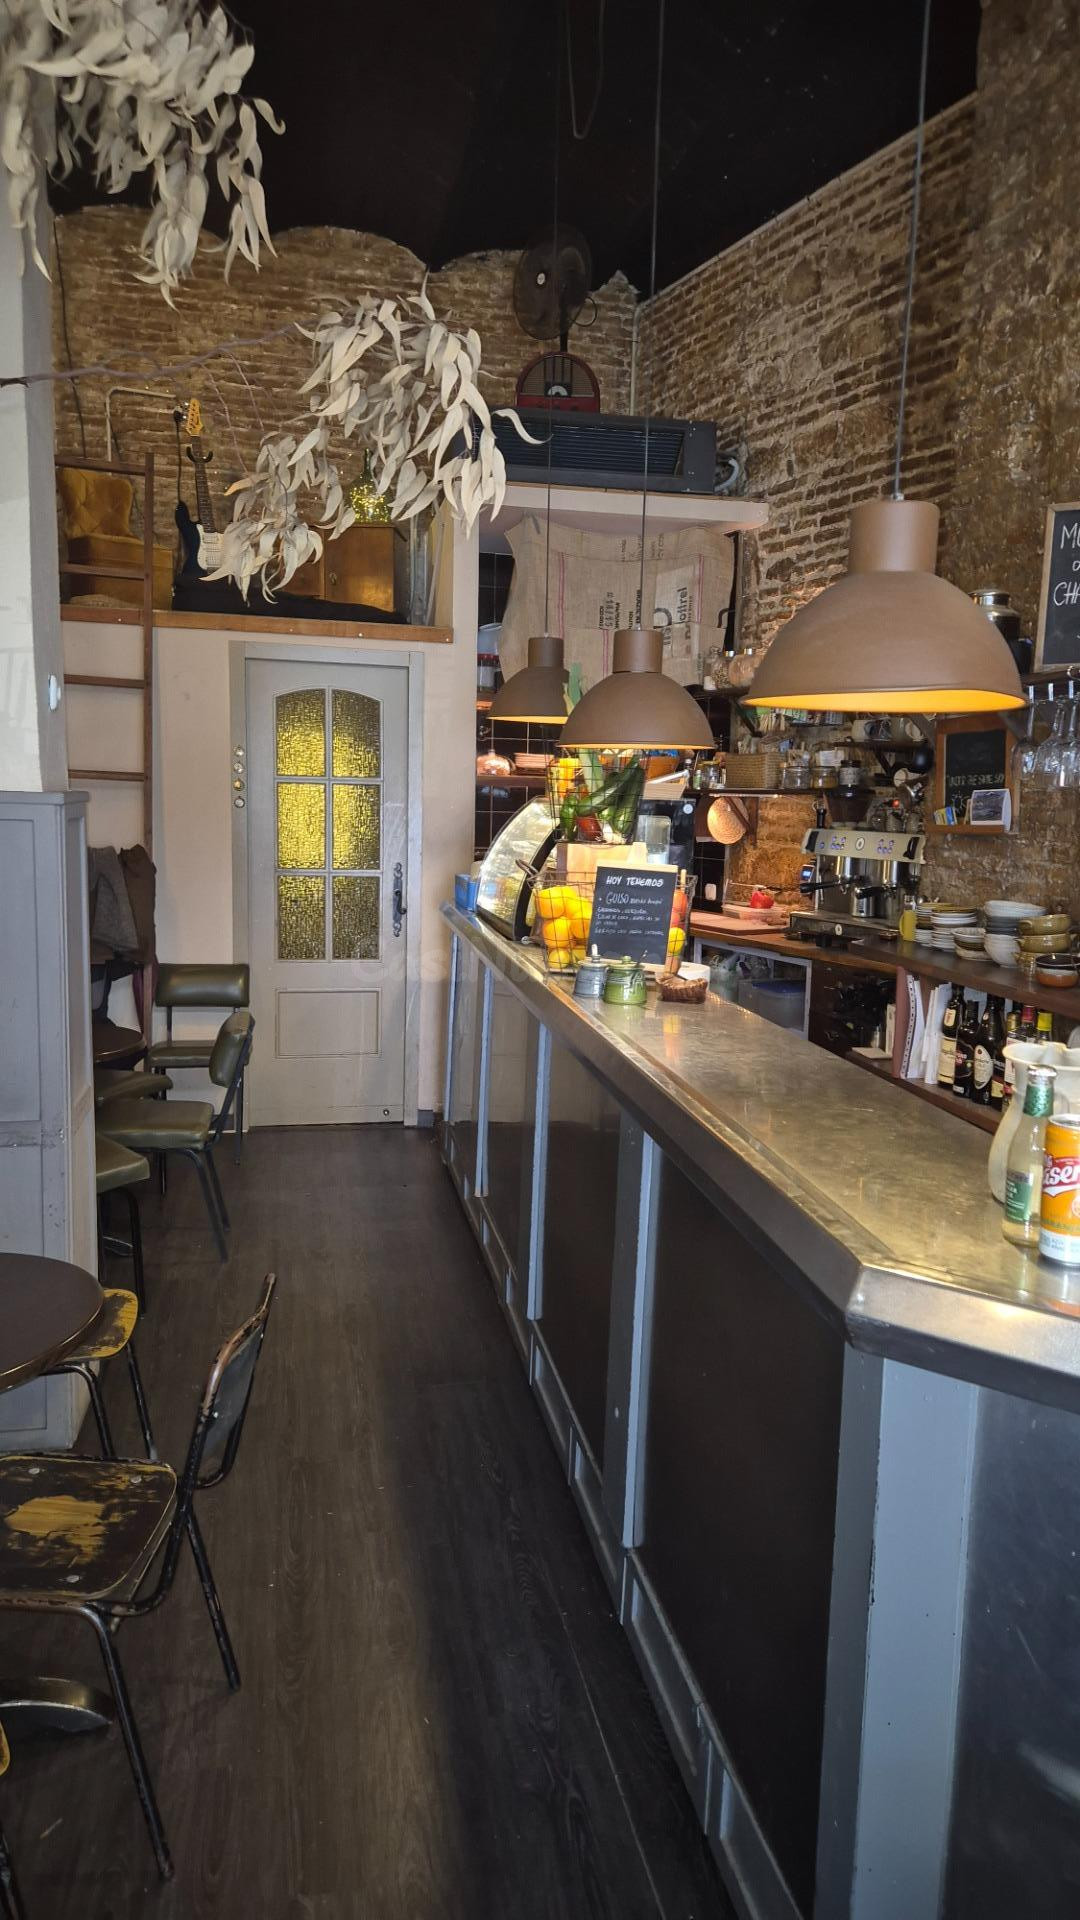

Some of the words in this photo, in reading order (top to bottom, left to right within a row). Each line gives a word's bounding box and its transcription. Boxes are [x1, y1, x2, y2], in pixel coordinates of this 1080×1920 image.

[1060, 522, 1080, 549] M
[606, 876, 622, 886] HOY
[626, 877, 664, 888] TENEMOS
